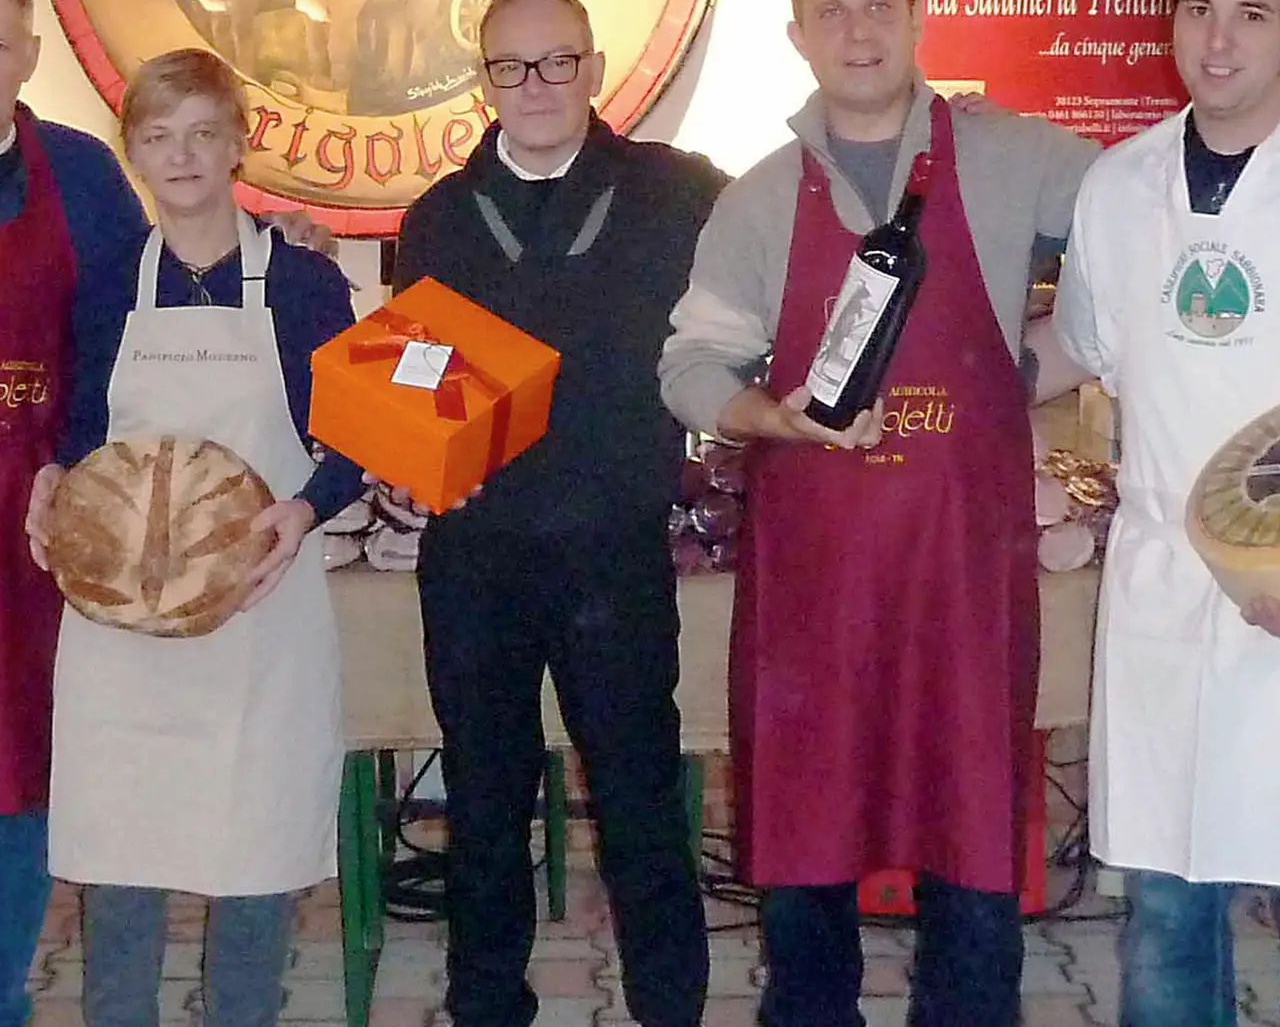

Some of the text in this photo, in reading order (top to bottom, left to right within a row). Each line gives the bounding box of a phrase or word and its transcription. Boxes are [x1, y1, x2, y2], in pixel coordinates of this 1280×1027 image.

[1073, 37, 1125, 65] cinque
[246, 84, 497, 190] rigolet
[881, 400, 956, 438] oletti
